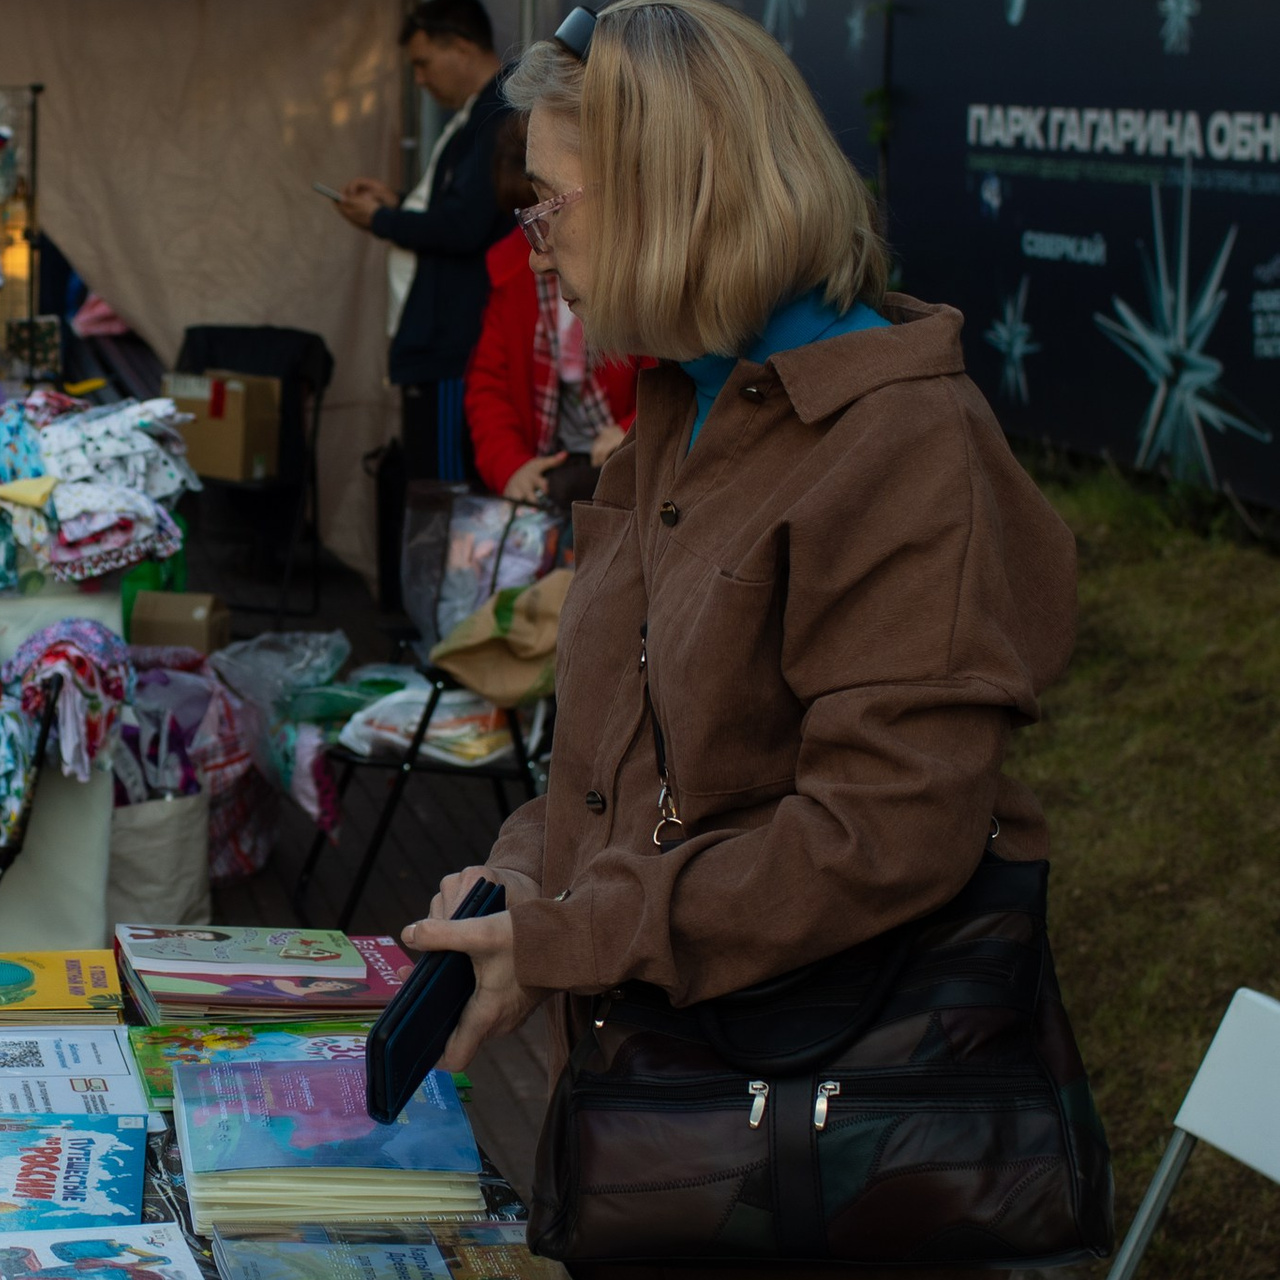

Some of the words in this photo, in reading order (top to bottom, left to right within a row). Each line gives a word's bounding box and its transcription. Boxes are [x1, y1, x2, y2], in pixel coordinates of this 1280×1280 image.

[966, 103, 1046, 149] ПАРК
[1046, 106, 1205, 159] ГАГАРИНА
[45, 1136, 62, 1146] ПО
[12, 1146, 63, 1200] РОССИИ
[61, 1137, 97, 1203] ПУТЕШЕСТВИЕ
[408, 1247, 430, 1271] Карты
